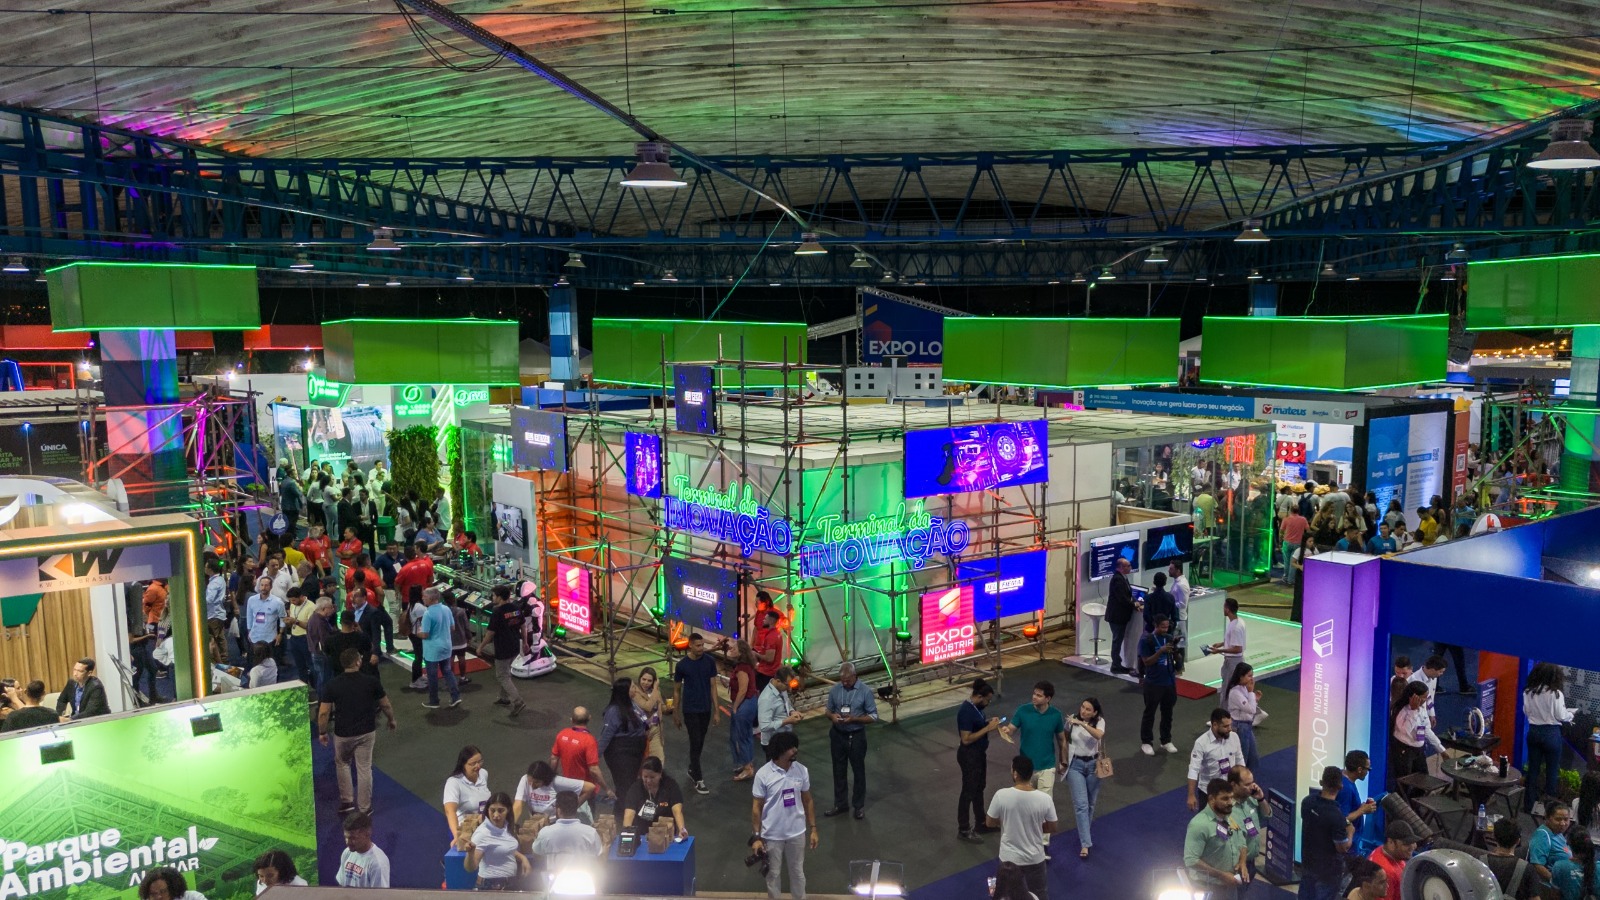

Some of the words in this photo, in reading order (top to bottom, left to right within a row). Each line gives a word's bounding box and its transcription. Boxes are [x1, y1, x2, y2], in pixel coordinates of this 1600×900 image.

[869, 340, 917, 356] EXPO
[919, 341, 943, 356] LO
[1132, 398, 1156, 407] Inovação
[1157, 400, 1168, 408] que
[1183, 400, 1197, 408] lucro
[1273, 406, 1307, 416] mateus
[41, 444, 68, 452] ÚNICA
[674, 474, 738, 513] Terminal
[739, 484, 758, 518] da
[664, 495, 792, 558] INOVAÇÃO
[818, 501, 906, 544] Terminal
[909, 500, 931, 530] da
[800, 517, 970, 578] INOVAÇÃO
[38, 549, 124, 582] KW
[79, 575, 113, 584] BRASIL
[560, 599, 589, 619] EXPO
[926, 625, 974, 647] EXPO
[926, 638, 974, 657] INDÚSTRIA
[1314, 663, 1324, 714] INDÚSTRIA
[1311, 718, 1328, 783] EXPO
[0, 826, 199, 900] Ambiental
[3, 828, 122, 871] Parque
